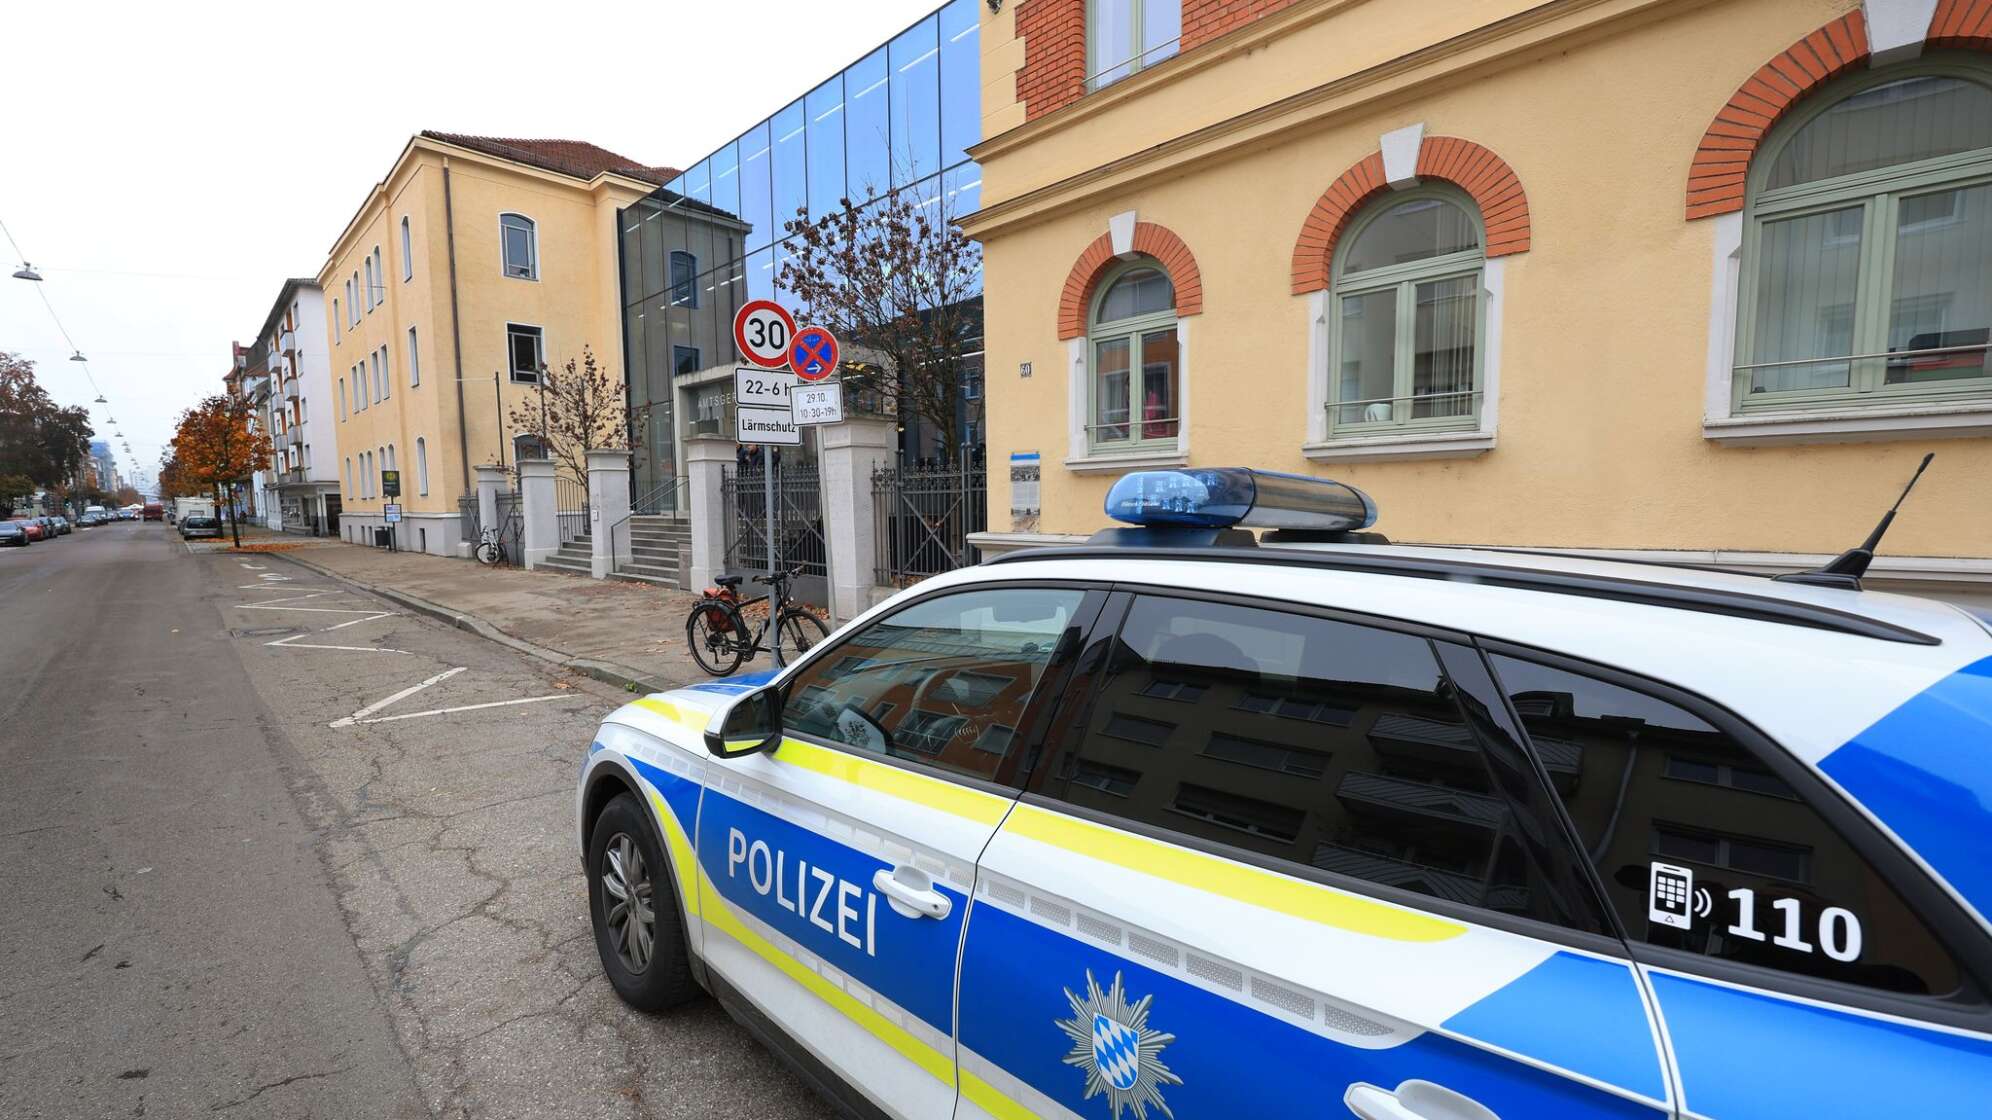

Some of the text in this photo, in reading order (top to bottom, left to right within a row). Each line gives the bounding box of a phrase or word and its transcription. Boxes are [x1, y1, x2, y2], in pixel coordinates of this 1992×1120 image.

[749, 317, 785, 350] 30
[745, 379, 780, 396] 22-6
[742, 418, 796, 433] Lärmschutz
[728, 826, 877, 957] POLIZEI
[1728, 887, 1862, 962] 110
